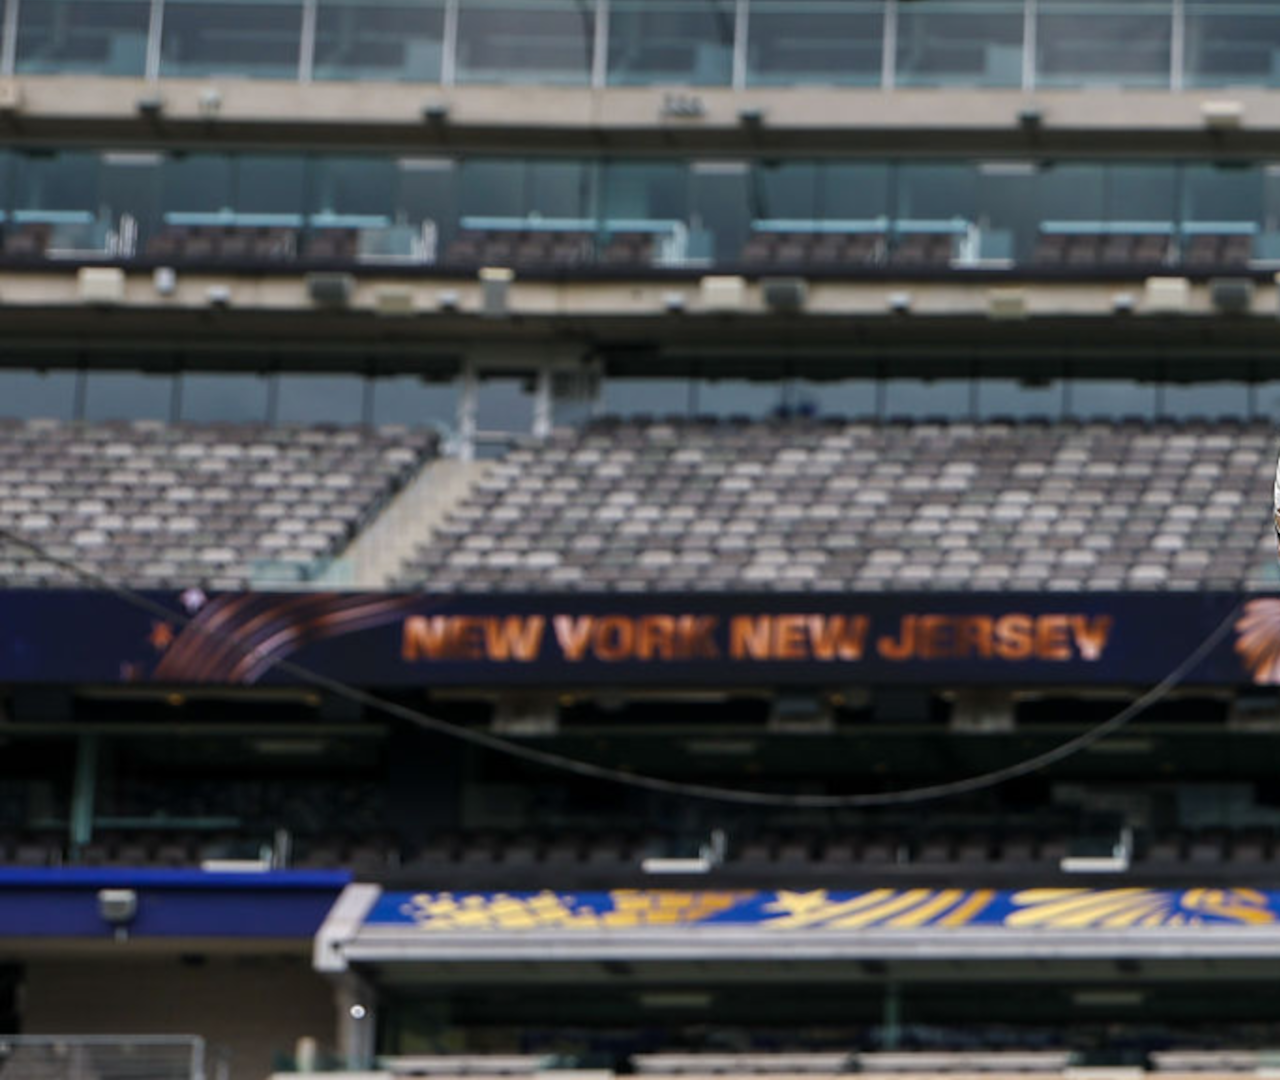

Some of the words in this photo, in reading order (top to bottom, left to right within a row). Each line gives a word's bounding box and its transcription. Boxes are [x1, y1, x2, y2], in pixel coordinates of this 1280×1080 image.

[402, 615, 545, 661] NEW
[551, 615, 722, 661] YORK
[729, 615, 870, 660] NEW
[876, 615, 1114, 660] JERSEY
